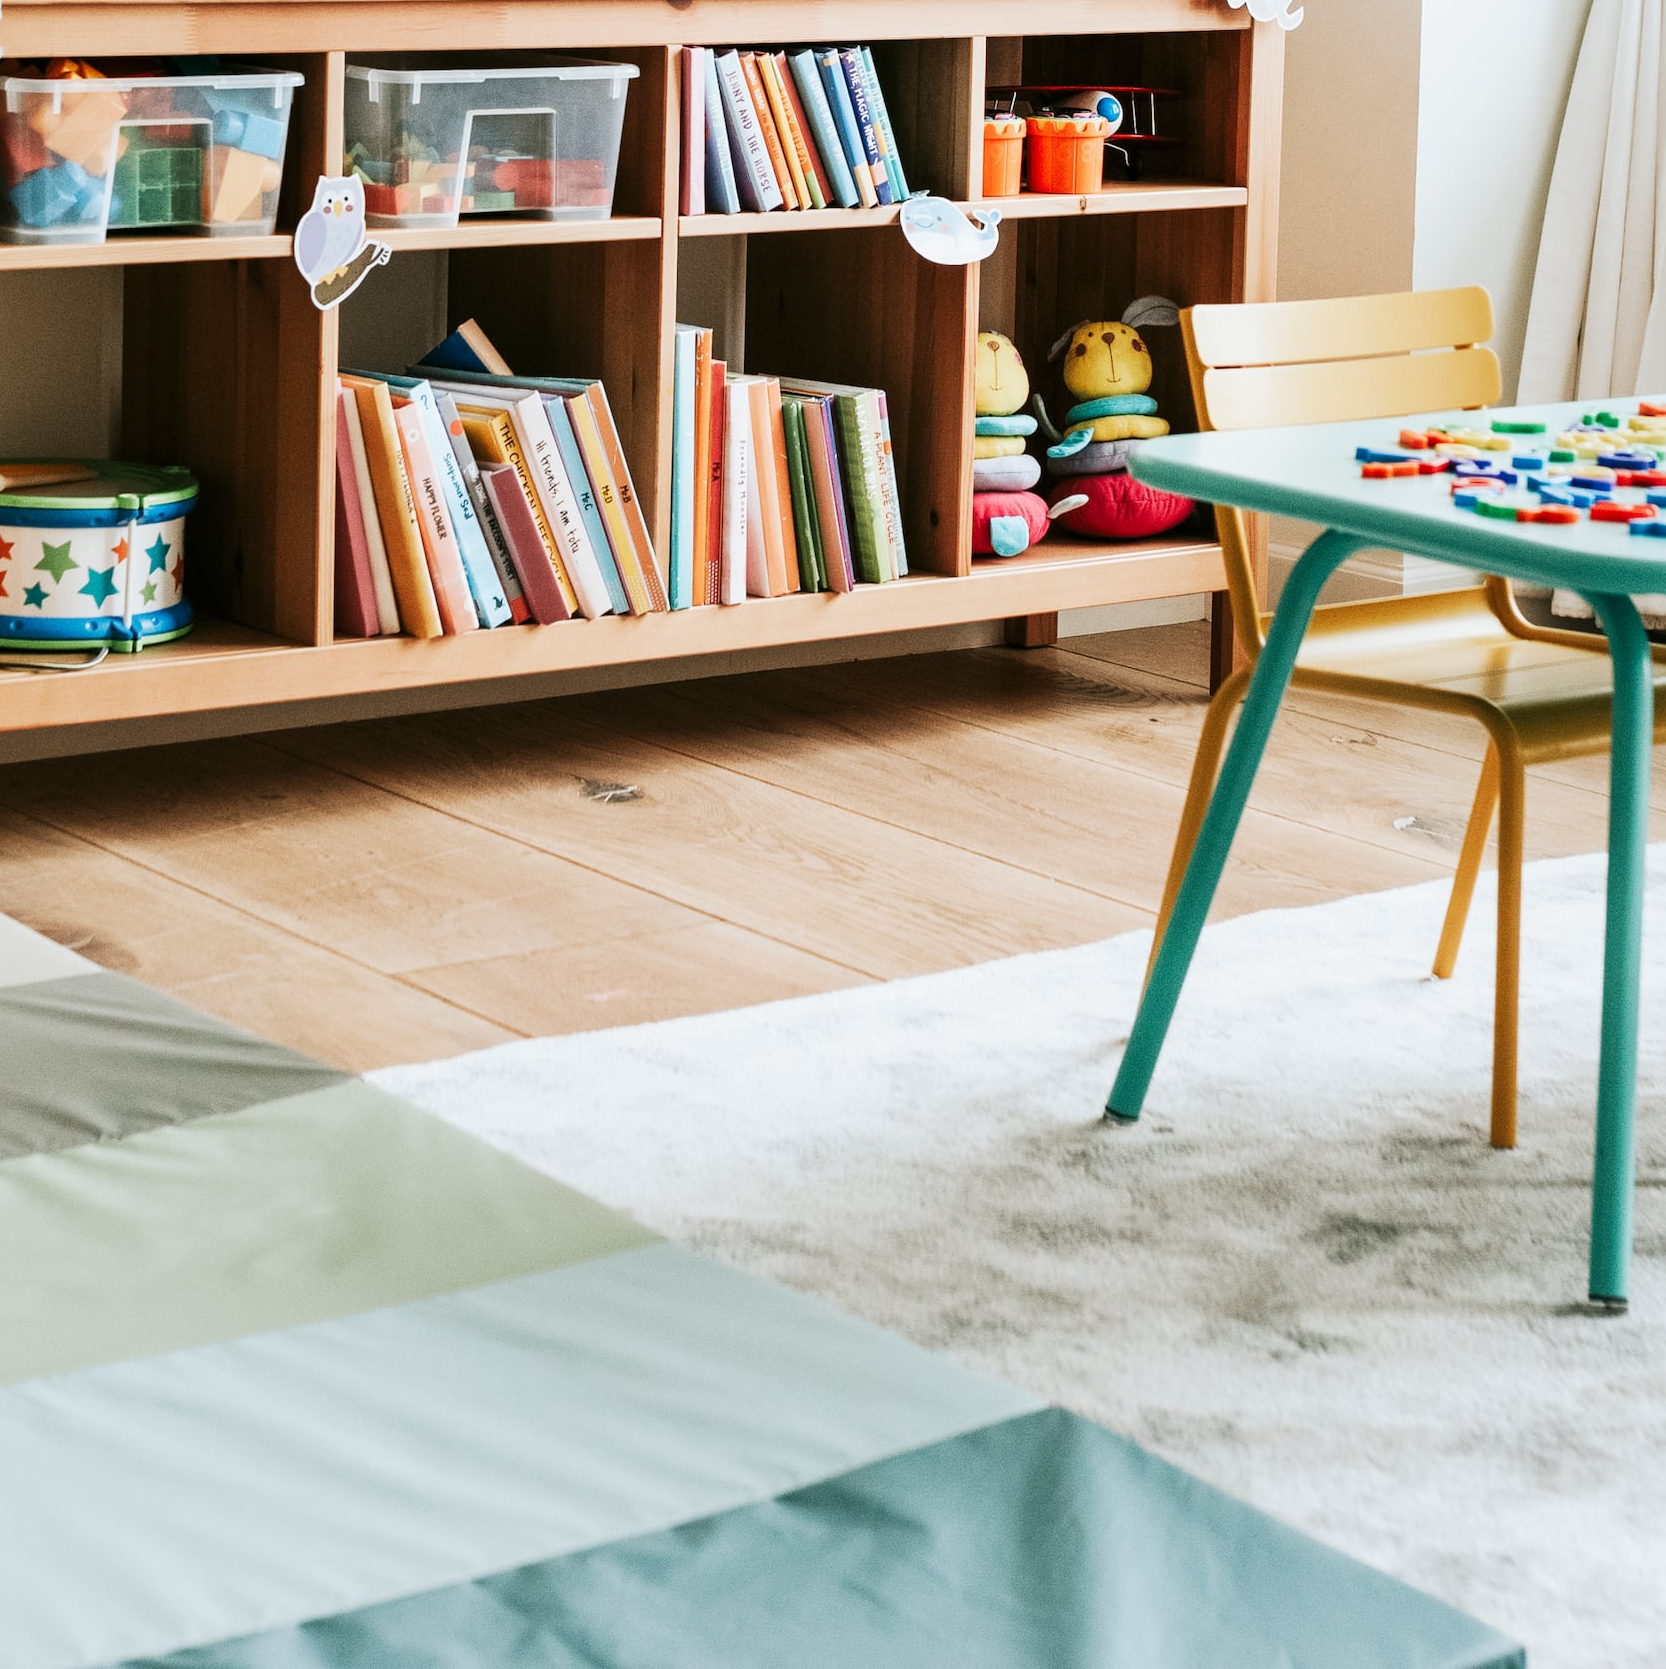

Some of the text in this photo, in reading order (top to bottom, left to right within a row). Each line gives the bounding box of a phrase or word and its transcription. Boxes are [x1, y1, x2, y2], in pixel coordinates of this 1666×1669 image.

[848, 67, 878, 156] THE MAGIC NIGHT
[726, 70, 745, 104] JENNY
[738, 109, 754, 130] AND
[746, 135, 760, 155] THE
[753, 159, 773, 194] HORSE
[499, 422, 516, 452] THE
[873, 431, 881, 439] A
[443, 453, 464, 498] Suspicious
[876, 444, 886, 477] PLANT
[536, 440, 545, 453] Hi
[559, 509, 570, 527] am
[601, 485, 614, 505] Mr.D
[620, 485, 632, 504] Mr.B
[880, 483, 891, 506] LIFE
[422, 477, 447, 540] HAPPY FLOWER
[581, 492, 594, 512] Mr.C
[885, 512, 895, 544] CYCLE
